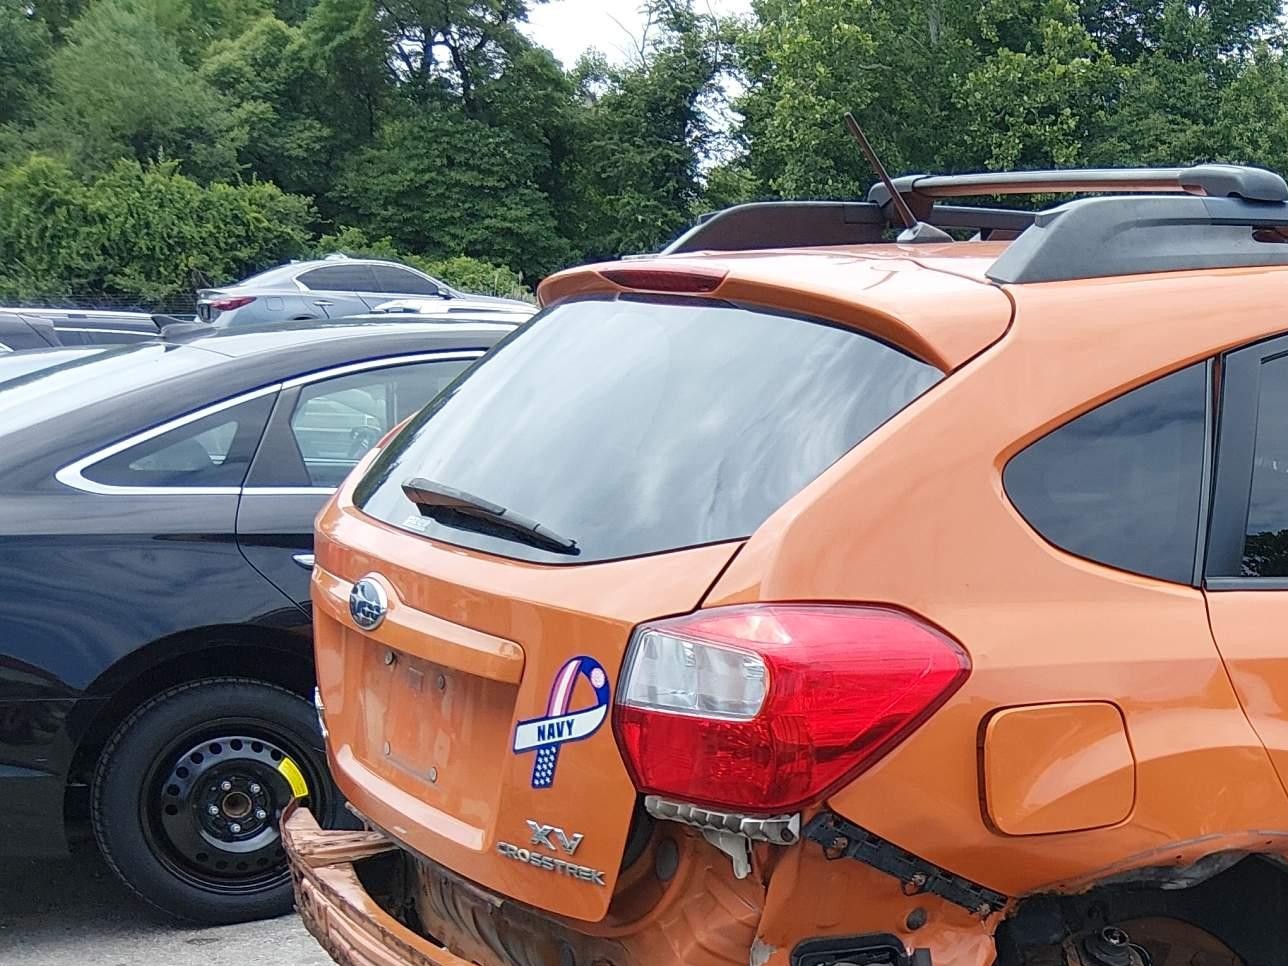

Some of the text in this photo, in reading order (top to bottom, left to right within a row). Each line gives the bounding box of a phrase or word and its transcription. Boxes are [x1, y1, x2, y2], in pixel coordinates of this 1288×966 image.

[537, 718, 575, 741] NAVY
[526, 819, 584, 855] XV
[496, 841, 606, 885] CROSSTREK
